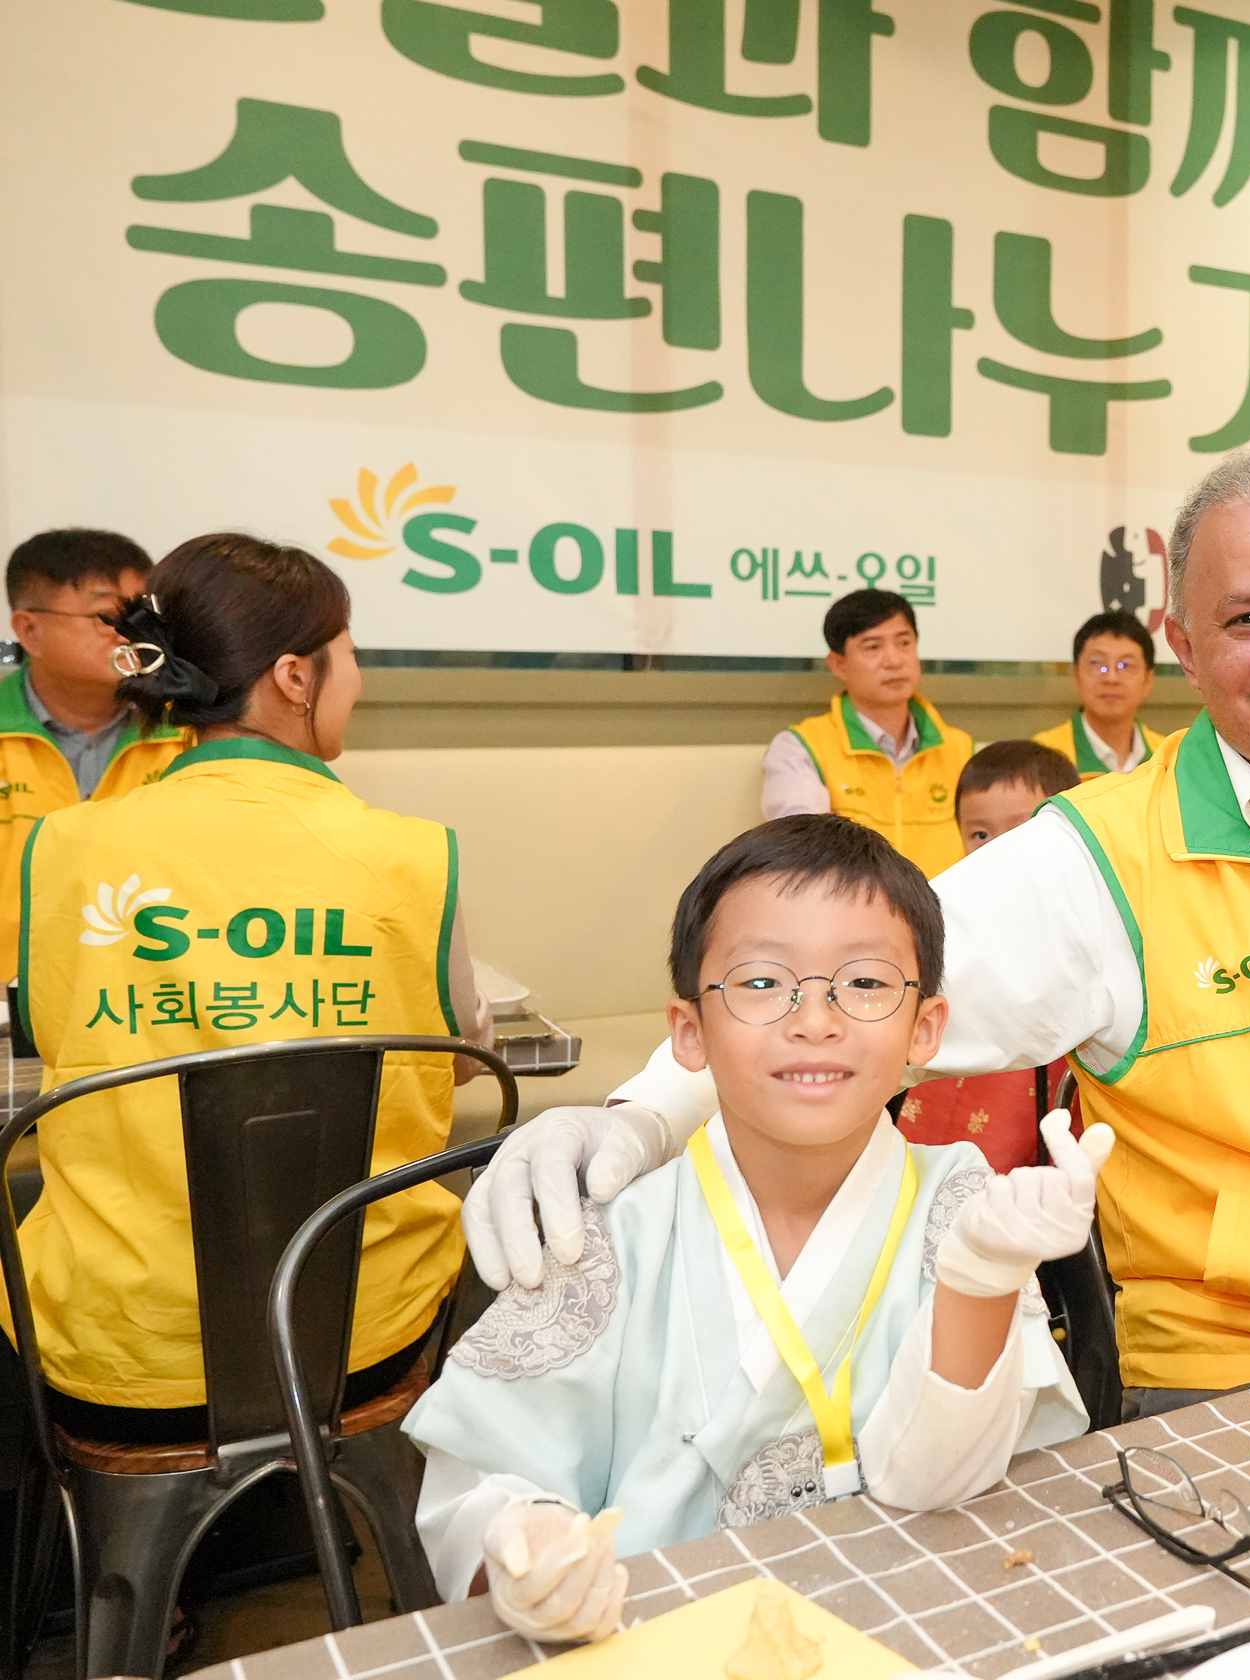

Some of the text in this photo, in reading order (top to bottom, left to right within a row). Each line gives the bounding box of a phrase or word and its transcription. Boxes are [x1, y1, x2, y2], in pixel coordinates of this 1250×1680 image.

[402, 512, 936, 606] S-OIL 에쓰-오일
[132, 905, 373, 962] S-OIL
[85, 979, 376, 1035] 사회봉사단
